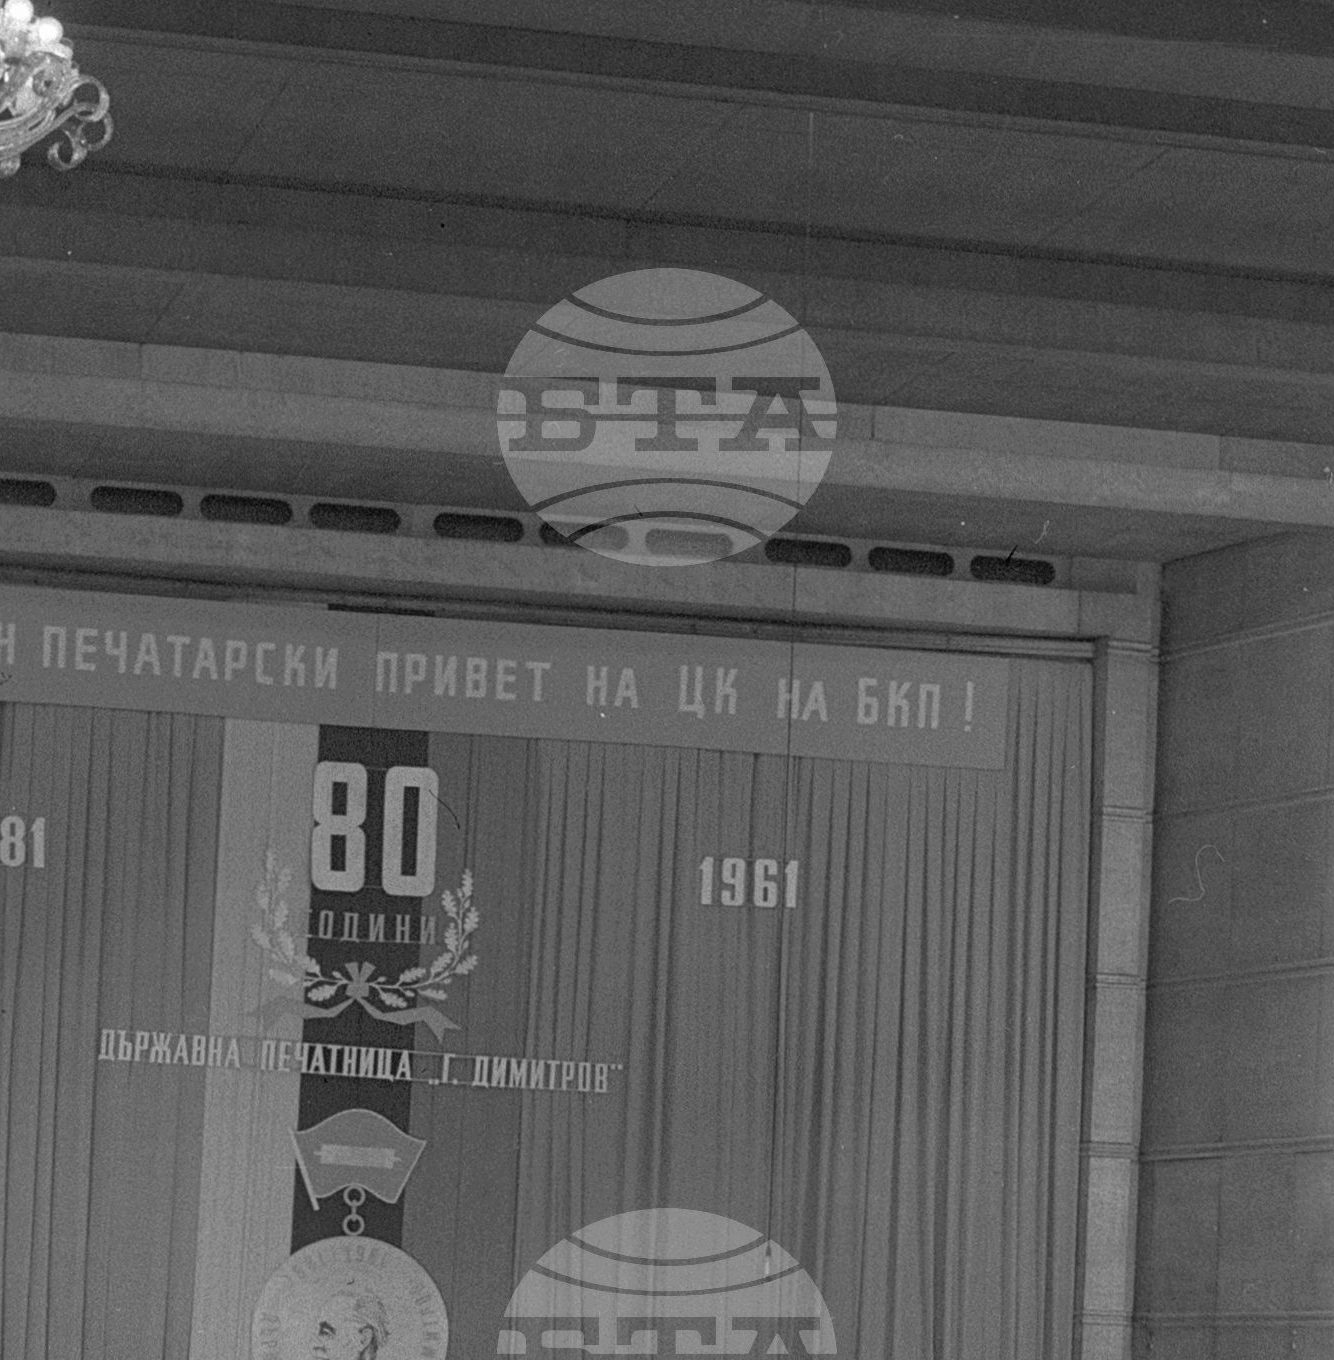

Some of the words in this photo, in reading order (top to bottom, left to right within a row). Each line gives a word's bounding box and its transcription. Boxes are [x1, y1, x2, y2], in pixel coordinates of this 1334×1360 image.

[41, 625, 340, 690] ПЕЧАТАРСКИ
[375, 651, 552, 703] ПРИВЕТ
[584, 664, 641, 709] НА
[676, 665, 740, 719] ЦК
[776, 675, 830, 723] НА
[311, 760, 441, 898] 80
[698, 856, 800, 909] 1961
[298, 907, 437, 945] ОДИНИ
[98, 1028, 241, 1071] ДЪРЖАВНА
[259, 1041, 413, 1082] ПЕЧАТНИЦА
